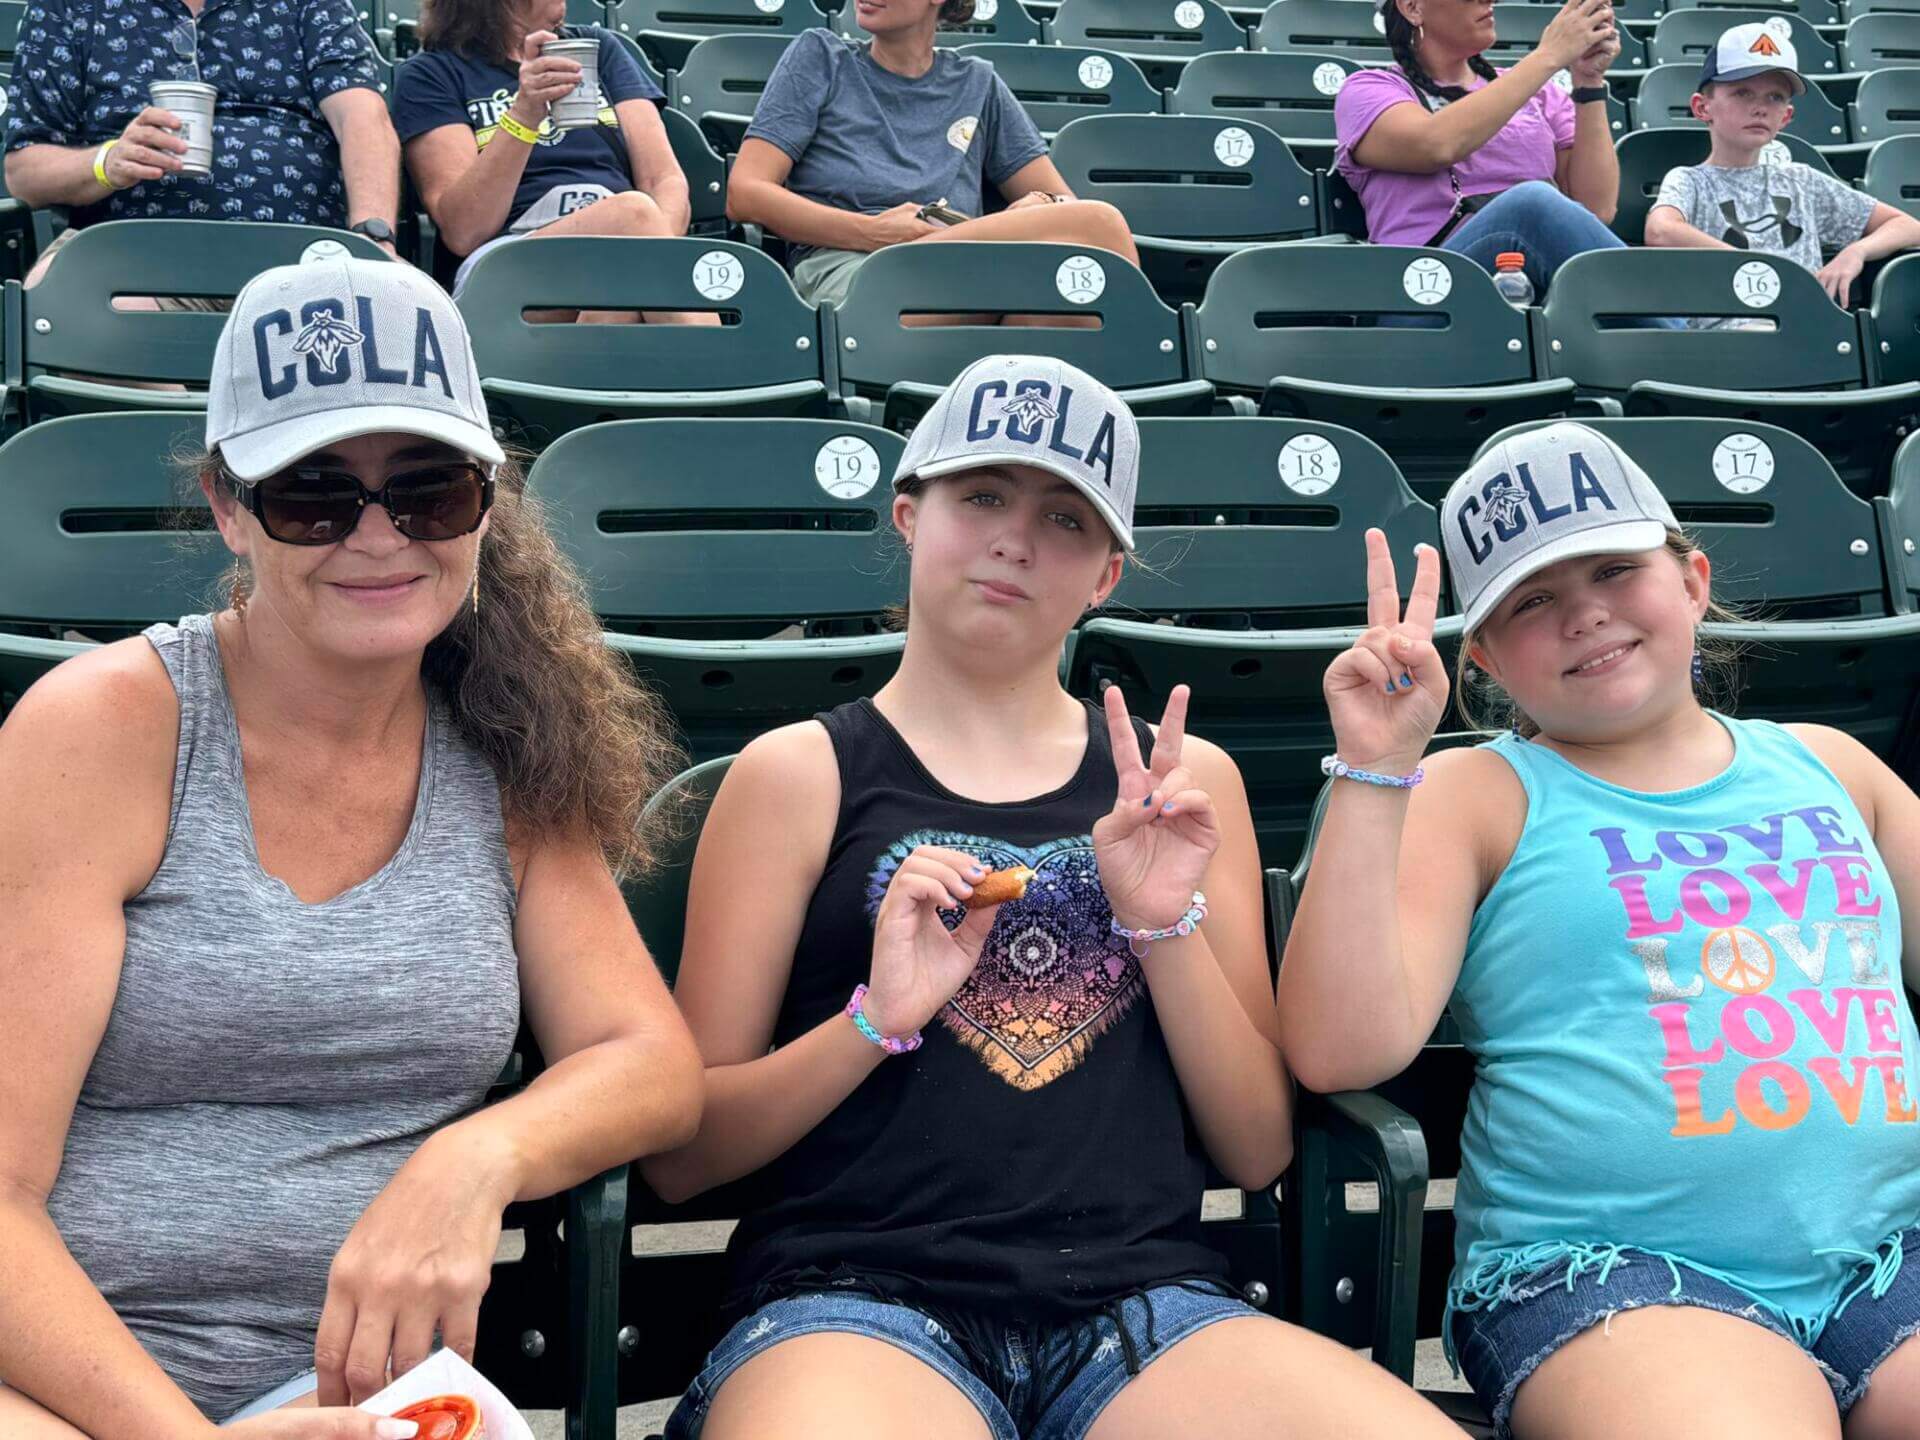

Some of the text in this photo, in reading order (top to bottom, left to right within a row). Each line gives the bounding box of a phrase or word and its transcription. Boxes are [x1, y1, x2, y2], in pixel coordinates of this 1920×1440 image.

[1089, 66, 1103, 79] 17
[1227, 139, 1243, 155] 17
[709, 266, 730, 285] 19
[1072, 270, 1092, 289] 18
[1419, 272, 1438, 290] 17
[1747, 275, 1768, 293] 16
[253, 295, 454, 400] COLA
[966, 379, 1115, 488] COLA
[833, 455, 861, 480] 19
[1297, 453, 1324, 476] 18
[1732, 453, 1757, 475] 17
[1457, 452, 1617, 566] COLA
[1589, 806, 1863, 875] LOVE
[1608, 856, 1882, 939] LOVE
[1649, 988, 1902, 1067] LOVE
[1662, 1056, 1917, 1137] LOVE
